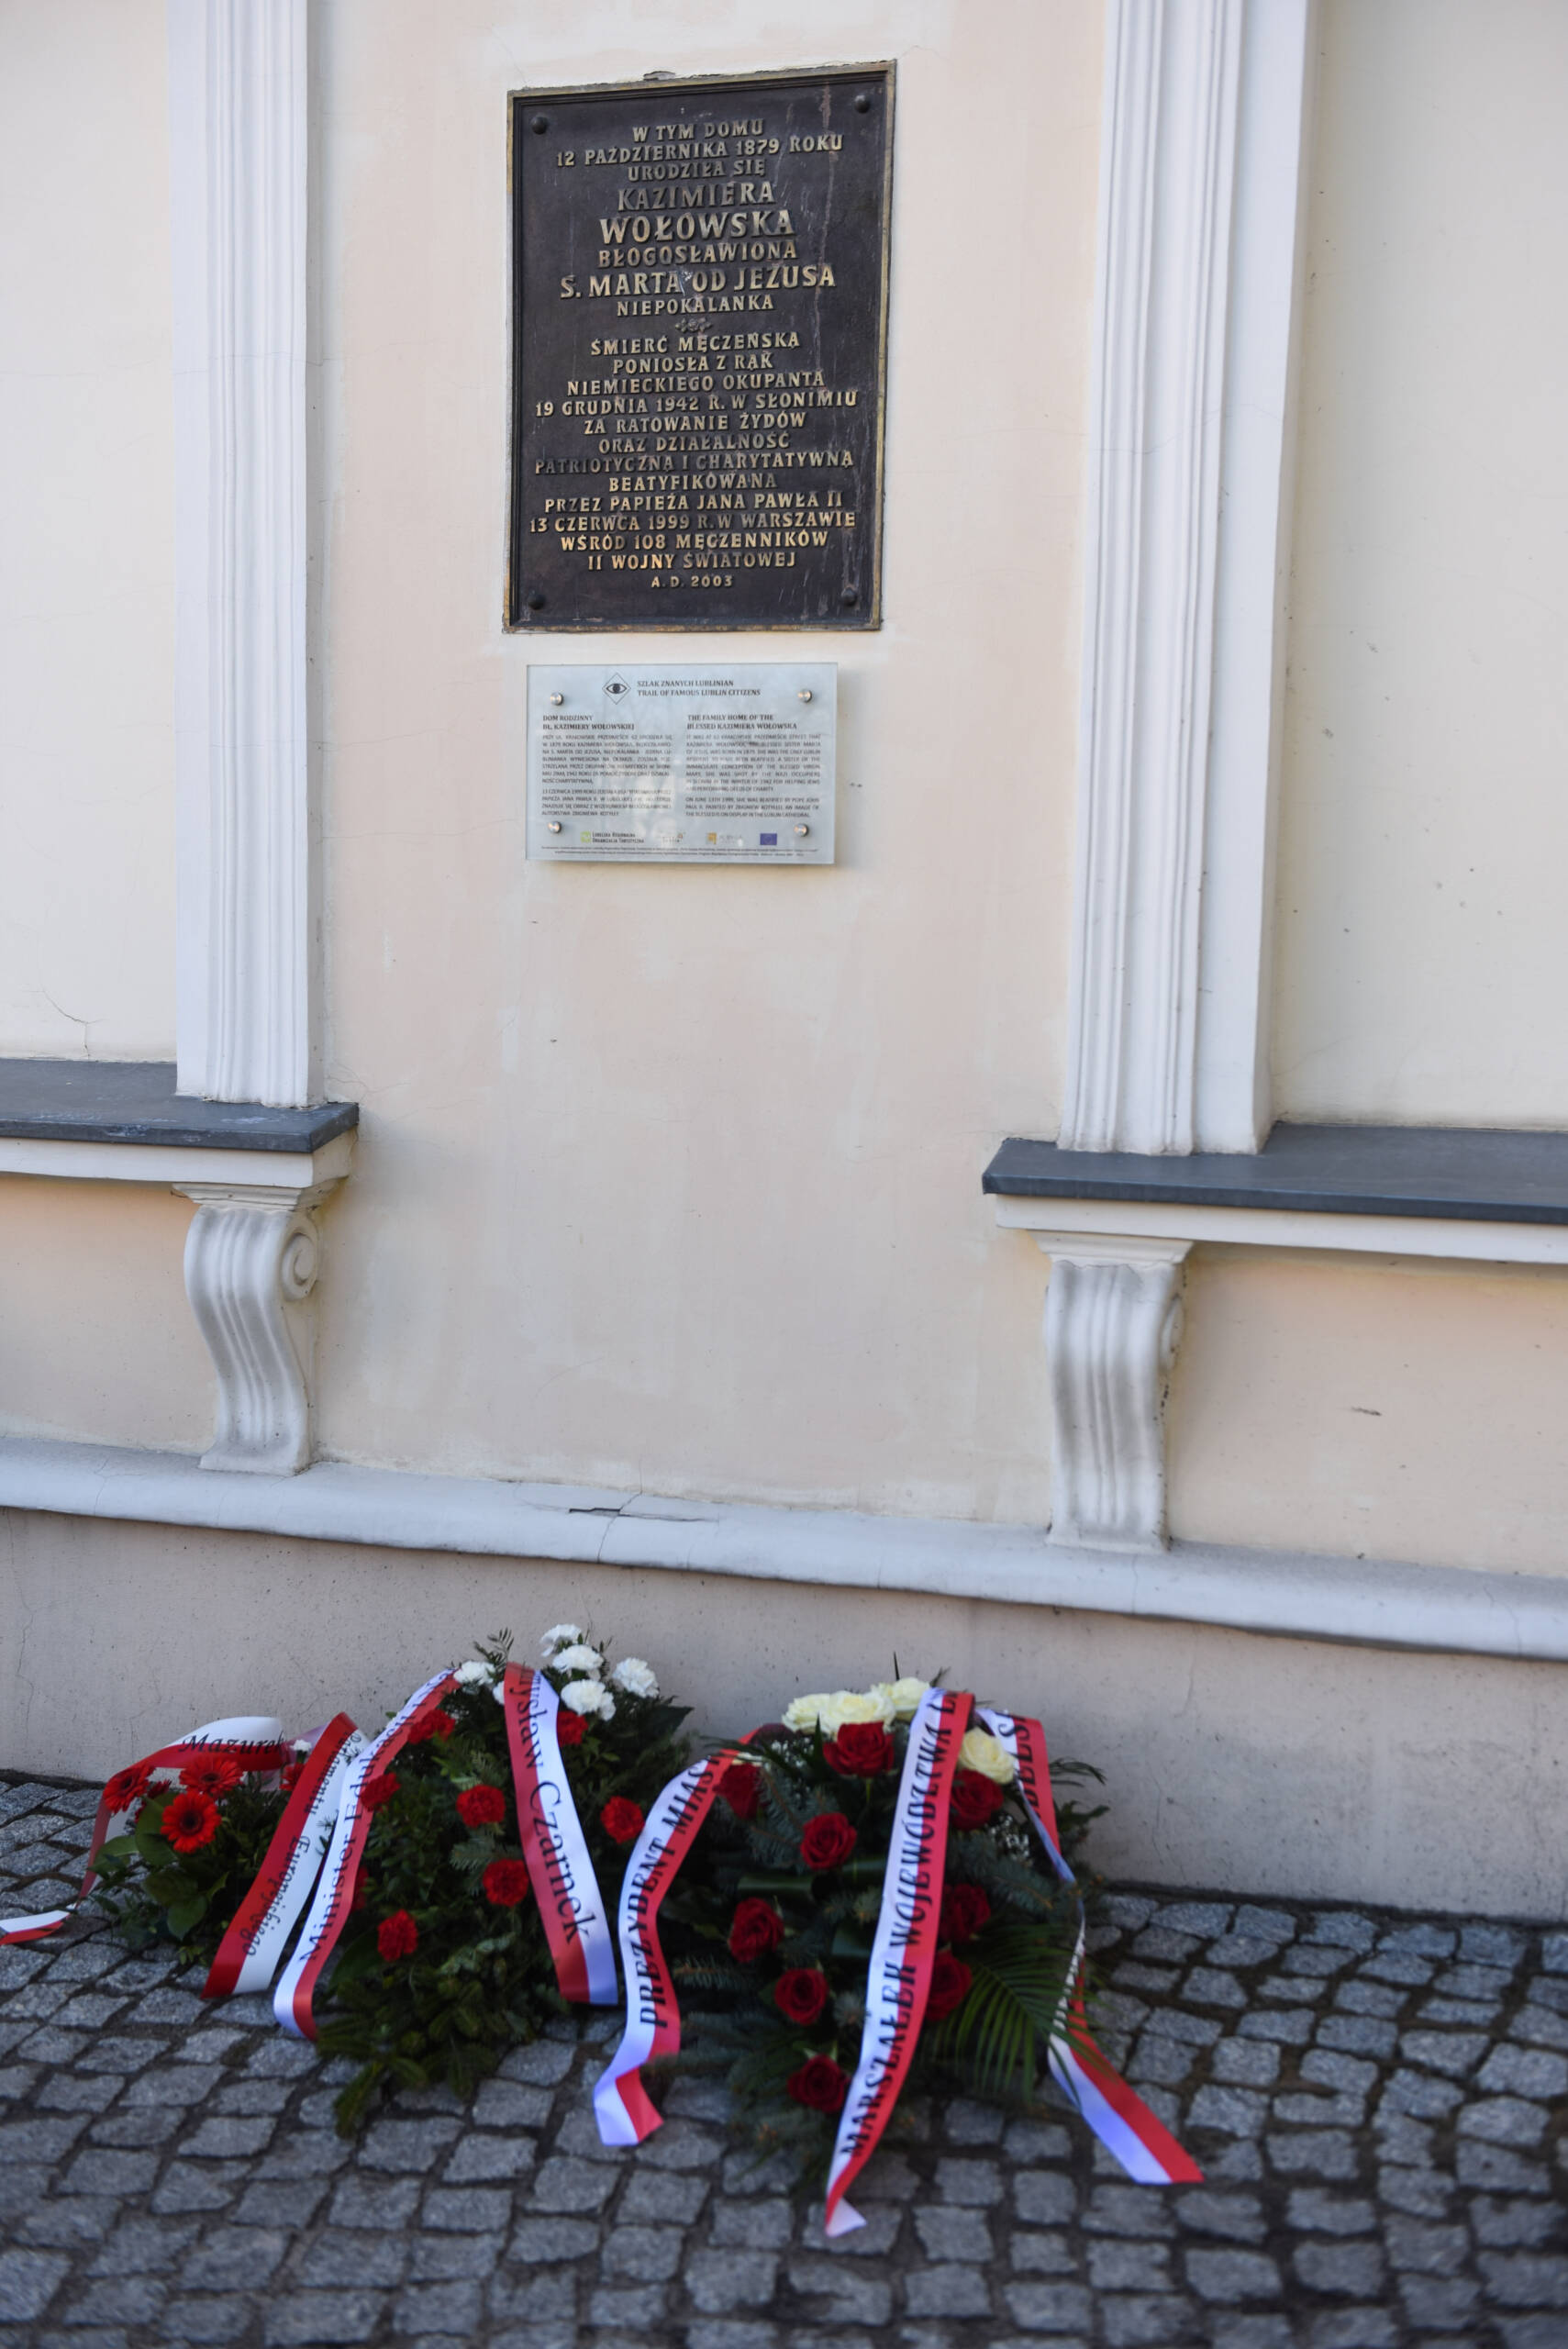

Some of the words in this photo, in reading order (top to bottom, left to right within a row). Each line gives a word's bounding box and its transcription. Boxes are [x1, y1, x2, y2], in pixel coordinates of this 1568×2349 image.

[632, 127, 650, 142] W
[656, 124, 694, 140] TYM
[705, 118, 763, 138] DOMU
[557, 150, 574, 167] 12
[584, 140, 728, 165] PAŹDZIERNIKA
[736, 139, 779, 156] 1879
[789, 134, 843, 152] ROKU
[627, 161, 725, 182] URODZIŁA
[733, 159, 765, 176] SIĘ
[617, 181, 776, 211] KAZIMIERA
[598, 240, 797, 268] BŁOGOSŁAWIONA
[588, 271, 684, 296] MARTA
[692, 270, 726, 292] OD
[734, 263, 836, 290] JEZUSA
[617, 294, 774, 316] NIEPOKALANKA
[590, 337, 667, 356] ŚMIERĆ
[678, 331, 800, 354] MĘCZEŃSKĄ
[612, 356, 709, 374] PONIOSŁA
[717, 355, 726, 370] Z
[735, 352, 773, 372] RĄK
[567, 375, 713, 395] NIEMIECKIEGO
[723, 370, 824, 389] OKUPANTA
[536, 402, 553, 417] 19
[562, 397, 648, 416] GRUDNIA
[656, 395, 698, 412] 1942
[733, 395, 747, 410] W
[756, 390, 858, 409] SŁONIMIU
[584, 419, 606, 435] ZA
[617, 415, 728, 434] RATOWANIE
[740, 409, 806, 429] ŻYDÓW
[599, 438, 646, 454] ORAZ
[656, 431, 790, 451] DZIAŁALNOŚĆ
[535, 455, 674, 474] PATRIOTYCZNĄ
[682, 454, 688, 470] I
[695, 451, 854, 470] CHARYTATYWNĄ
[609, 472, 777, 492] BEATYFIKOWANA
[545, 497, 602, 513] PRZEZ
[609, 493, 688, 511] PAPIEŻA
[697, 493, 746, 509] JANA
[754, 491, 818, 508] PAWŁA
[828, 491, 842, 506] II
[529, 518, 547, 532] 13
[555, 516, 639, 532] CZERWCA
[649, 513, 689, 529] 1999
[741, 511, 855, 529] WARSZAWIE
[561, 533, 625, 551] WŚRÓD
[634, 534, 666, 550] 108
[676, 529, 828, 551] MĘCZENNIKÓW
[588, 555, 602, 570] II
[612, 554, 675, 570] WOJNY
[683, 550, 795, 568] ŚWIATOWEJ
[691, 574, 734, 588] 2003
[178, 1730, 286, 1755] Mazurek
[529, 1781, 596, 1944] Czarnek
[239, 1835, 311, 1956] Europejskiego
[299, 1836, 357, 1962] Minister
[628, 1837, 676, 2028] PREZYDENT
[840, 1961, 916, 2155] MARSZAŁEK
[889, 1722, 953, 1947] WOJEWÓDZTWA
